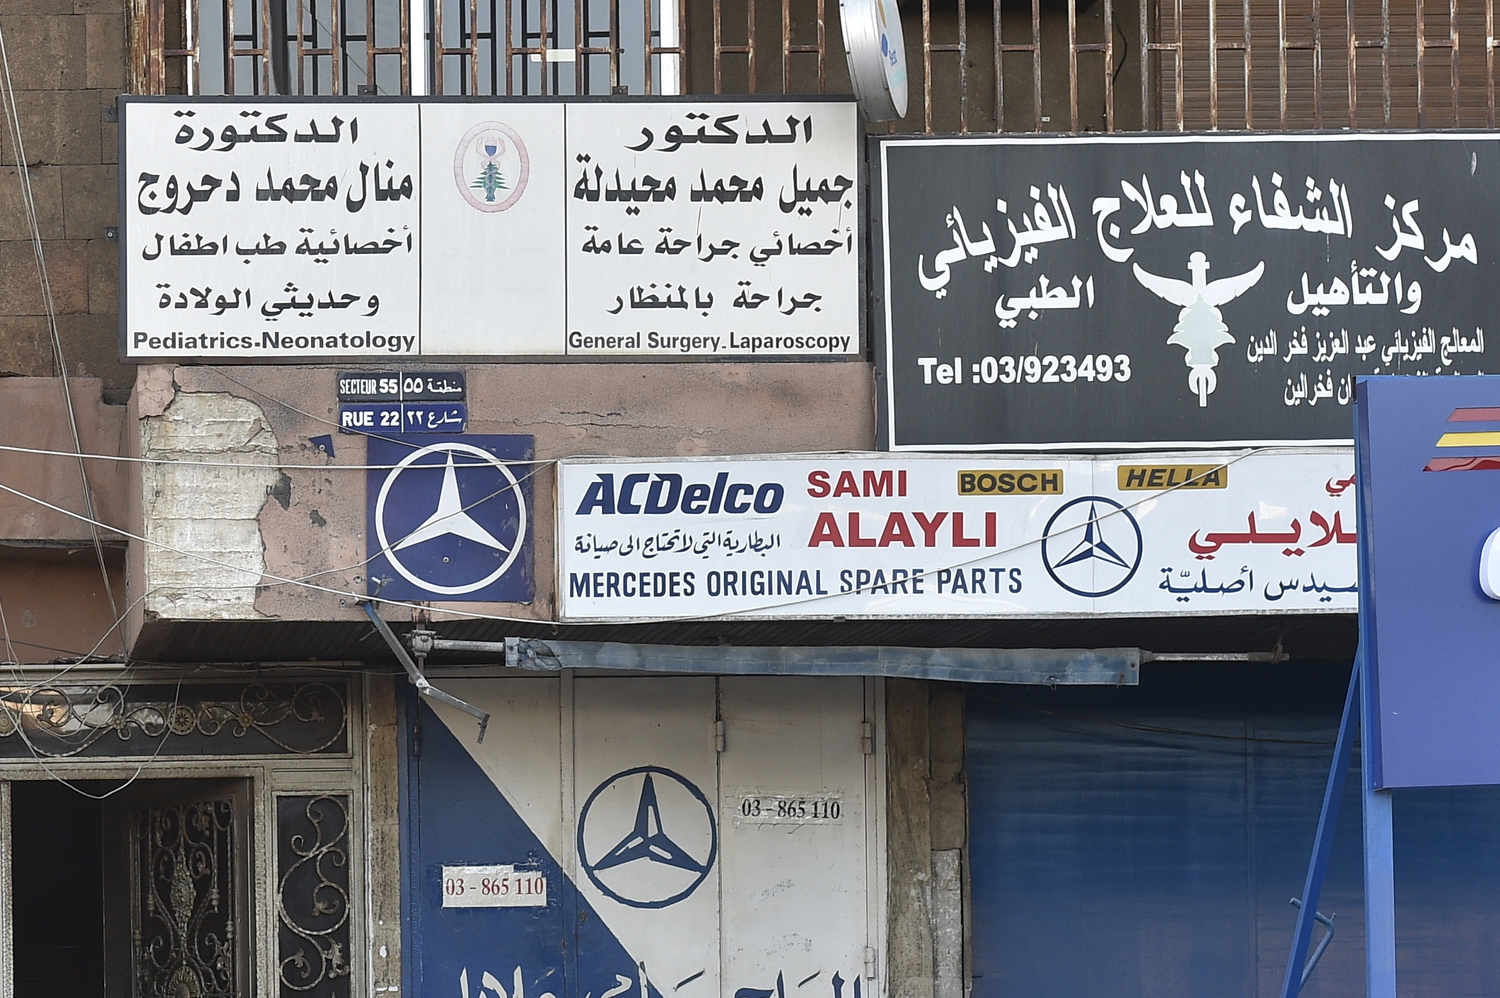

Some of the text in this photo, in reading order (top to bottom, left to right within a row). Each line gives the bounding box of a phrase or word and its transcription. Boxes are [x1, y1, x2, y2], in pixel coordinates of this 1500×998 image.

[173, 110, 358, 152] الدكتورة
[624, 112, 812, 152] الدكتور
[137, 159, 413, 215] منال محمد دحروج
[573, 153, 853, 216] جميل محمد محيدلة
[142, 225, 412, 265] أخصائية طب اطفال
[582, 225, 852, 267] أخصائي جراحة عامة
[918, 169, 1478, 299] مركز الشفاء للعلاج الفيزيائي
[155, 282, 379, 321] وحديثي الولادة
[606, 280, 822, 317] جراحة بالمنظار
[995, 260, 1422, 328] والتأهيل الطبي
[569, 332, 640, 349] General
[1247, 326, 1484, 366] المعالج الفيزيائي عبد العزيز فخر الدين
[917, 354, 1131, 384] Tel :03/923493
[340, 379, 398, 394] SECTEUR 55
[427, 378, 462, 394] منطقة
[342, 411, 400, 427] RUE 22
[407, 410, 463, 429] شارع ٢٢
[807, 470, 907, 498] SAMI
[960, 472, 1058, 493] BOSCH
[1125, 468, 1221, 487] HELLA
[575, 471, 784, 516] ACDelco
[694, 530, 721, 559] التي
[723, 529, 780, 557] البطارية
[808, 511, 996, 548] ALAYLI
[1188, 510, 1357, 560] لايلي
[575, 532, 618, 559] صيانة
[569, 567, 1022, 598] MERCEDES ORIGINAL SPARE PARTS
[742, 799, 760, 817] 03
[777, 799, 806, 818] 865
[812, 800, 840, 820] 110
[446, 878, 464, 896] 03
[481, 877, 510, 896] 865
[514, 877, 544, 896] 110
